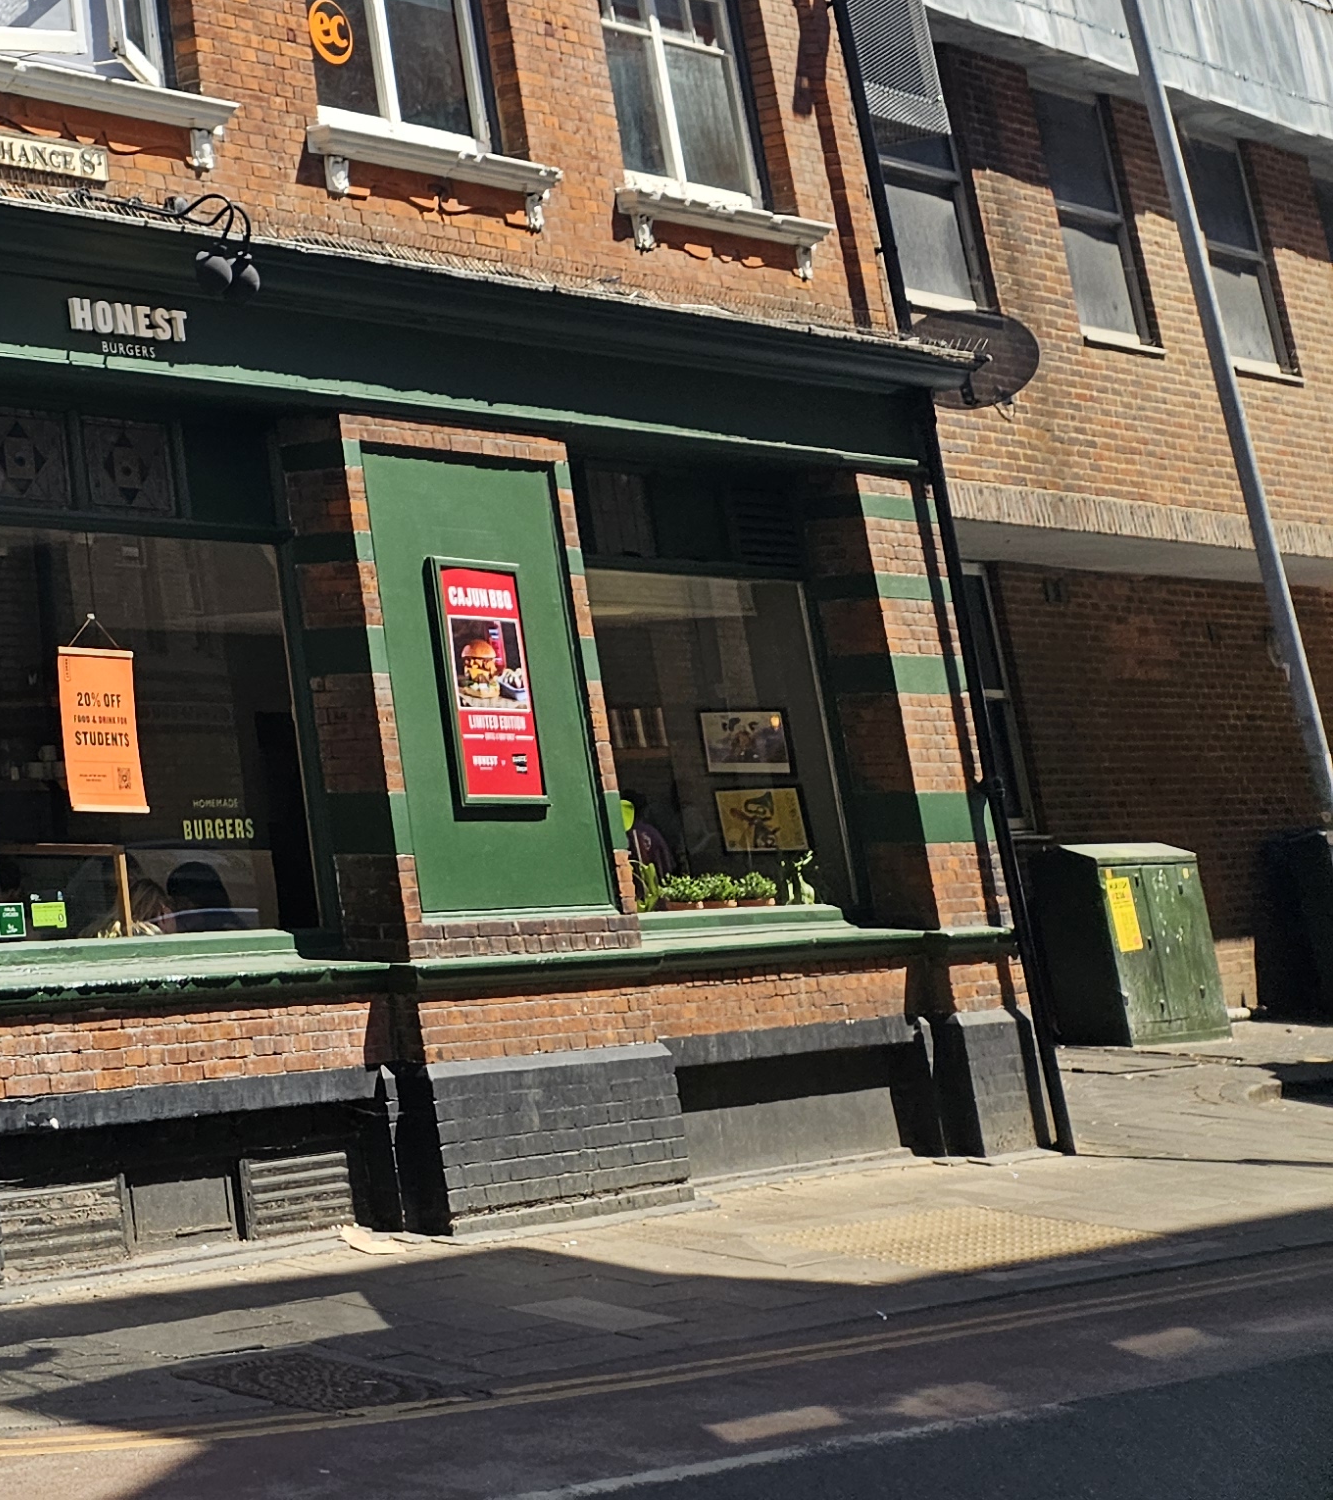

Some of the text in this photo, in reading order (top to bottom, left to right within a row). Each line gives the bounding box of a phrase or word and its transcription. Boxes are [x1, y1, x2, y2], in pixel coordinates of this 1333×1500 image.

[67, 297, 188, 342] HONEST
[101, 340, 156, 359] BURGERS
[448, 585, 513, 611] CAJUN BBQ
[76, 692, 122, 709] 20% OFF
[75, 730, 130, 748] STUDENTS
[192, 798, 239, 809] HOMEMADE
[182, 818, 255, 841] BURGERS
